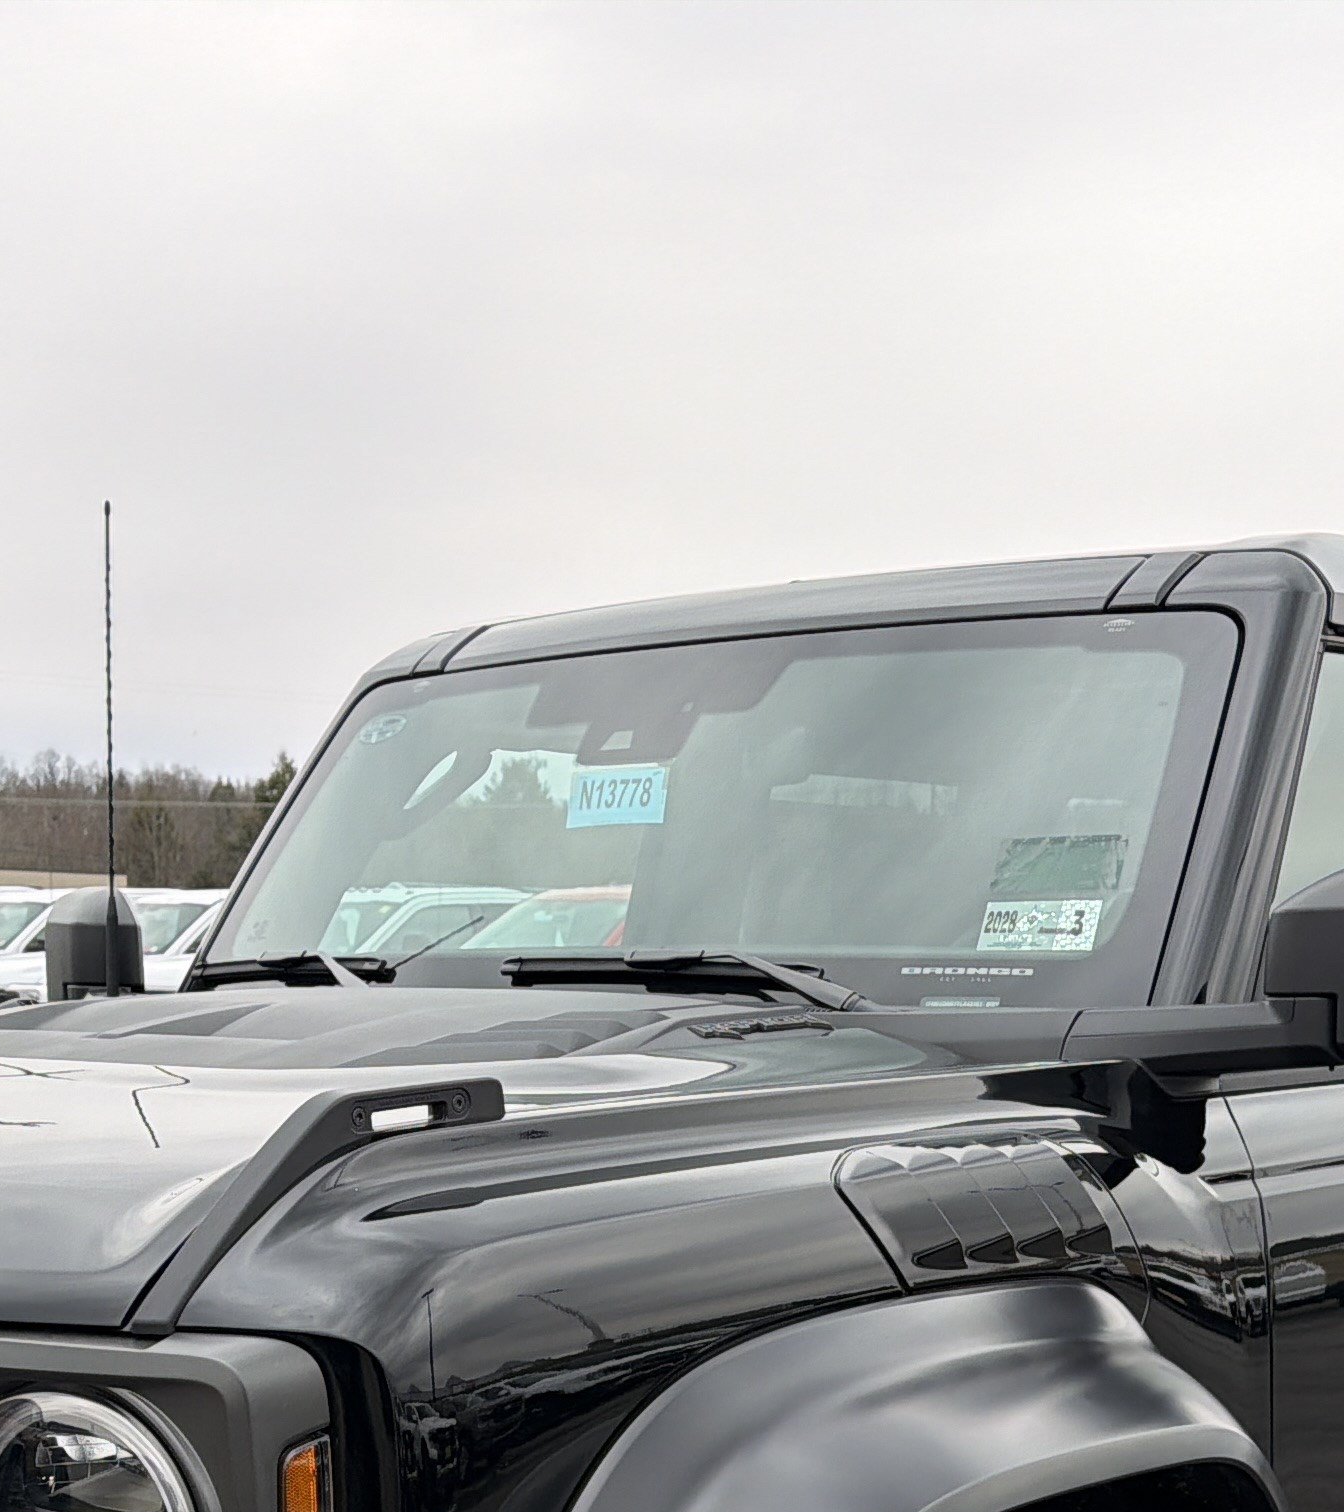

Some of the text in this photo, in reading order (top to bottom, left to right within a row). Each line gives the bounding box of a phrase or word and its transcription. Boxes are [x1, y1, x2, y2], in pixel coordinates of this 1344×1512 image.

[578, 776, 654, 811] N13778
[982, 908, 1086, 936] 2028 3
[900, 966, 1034, 977] BRONCO
